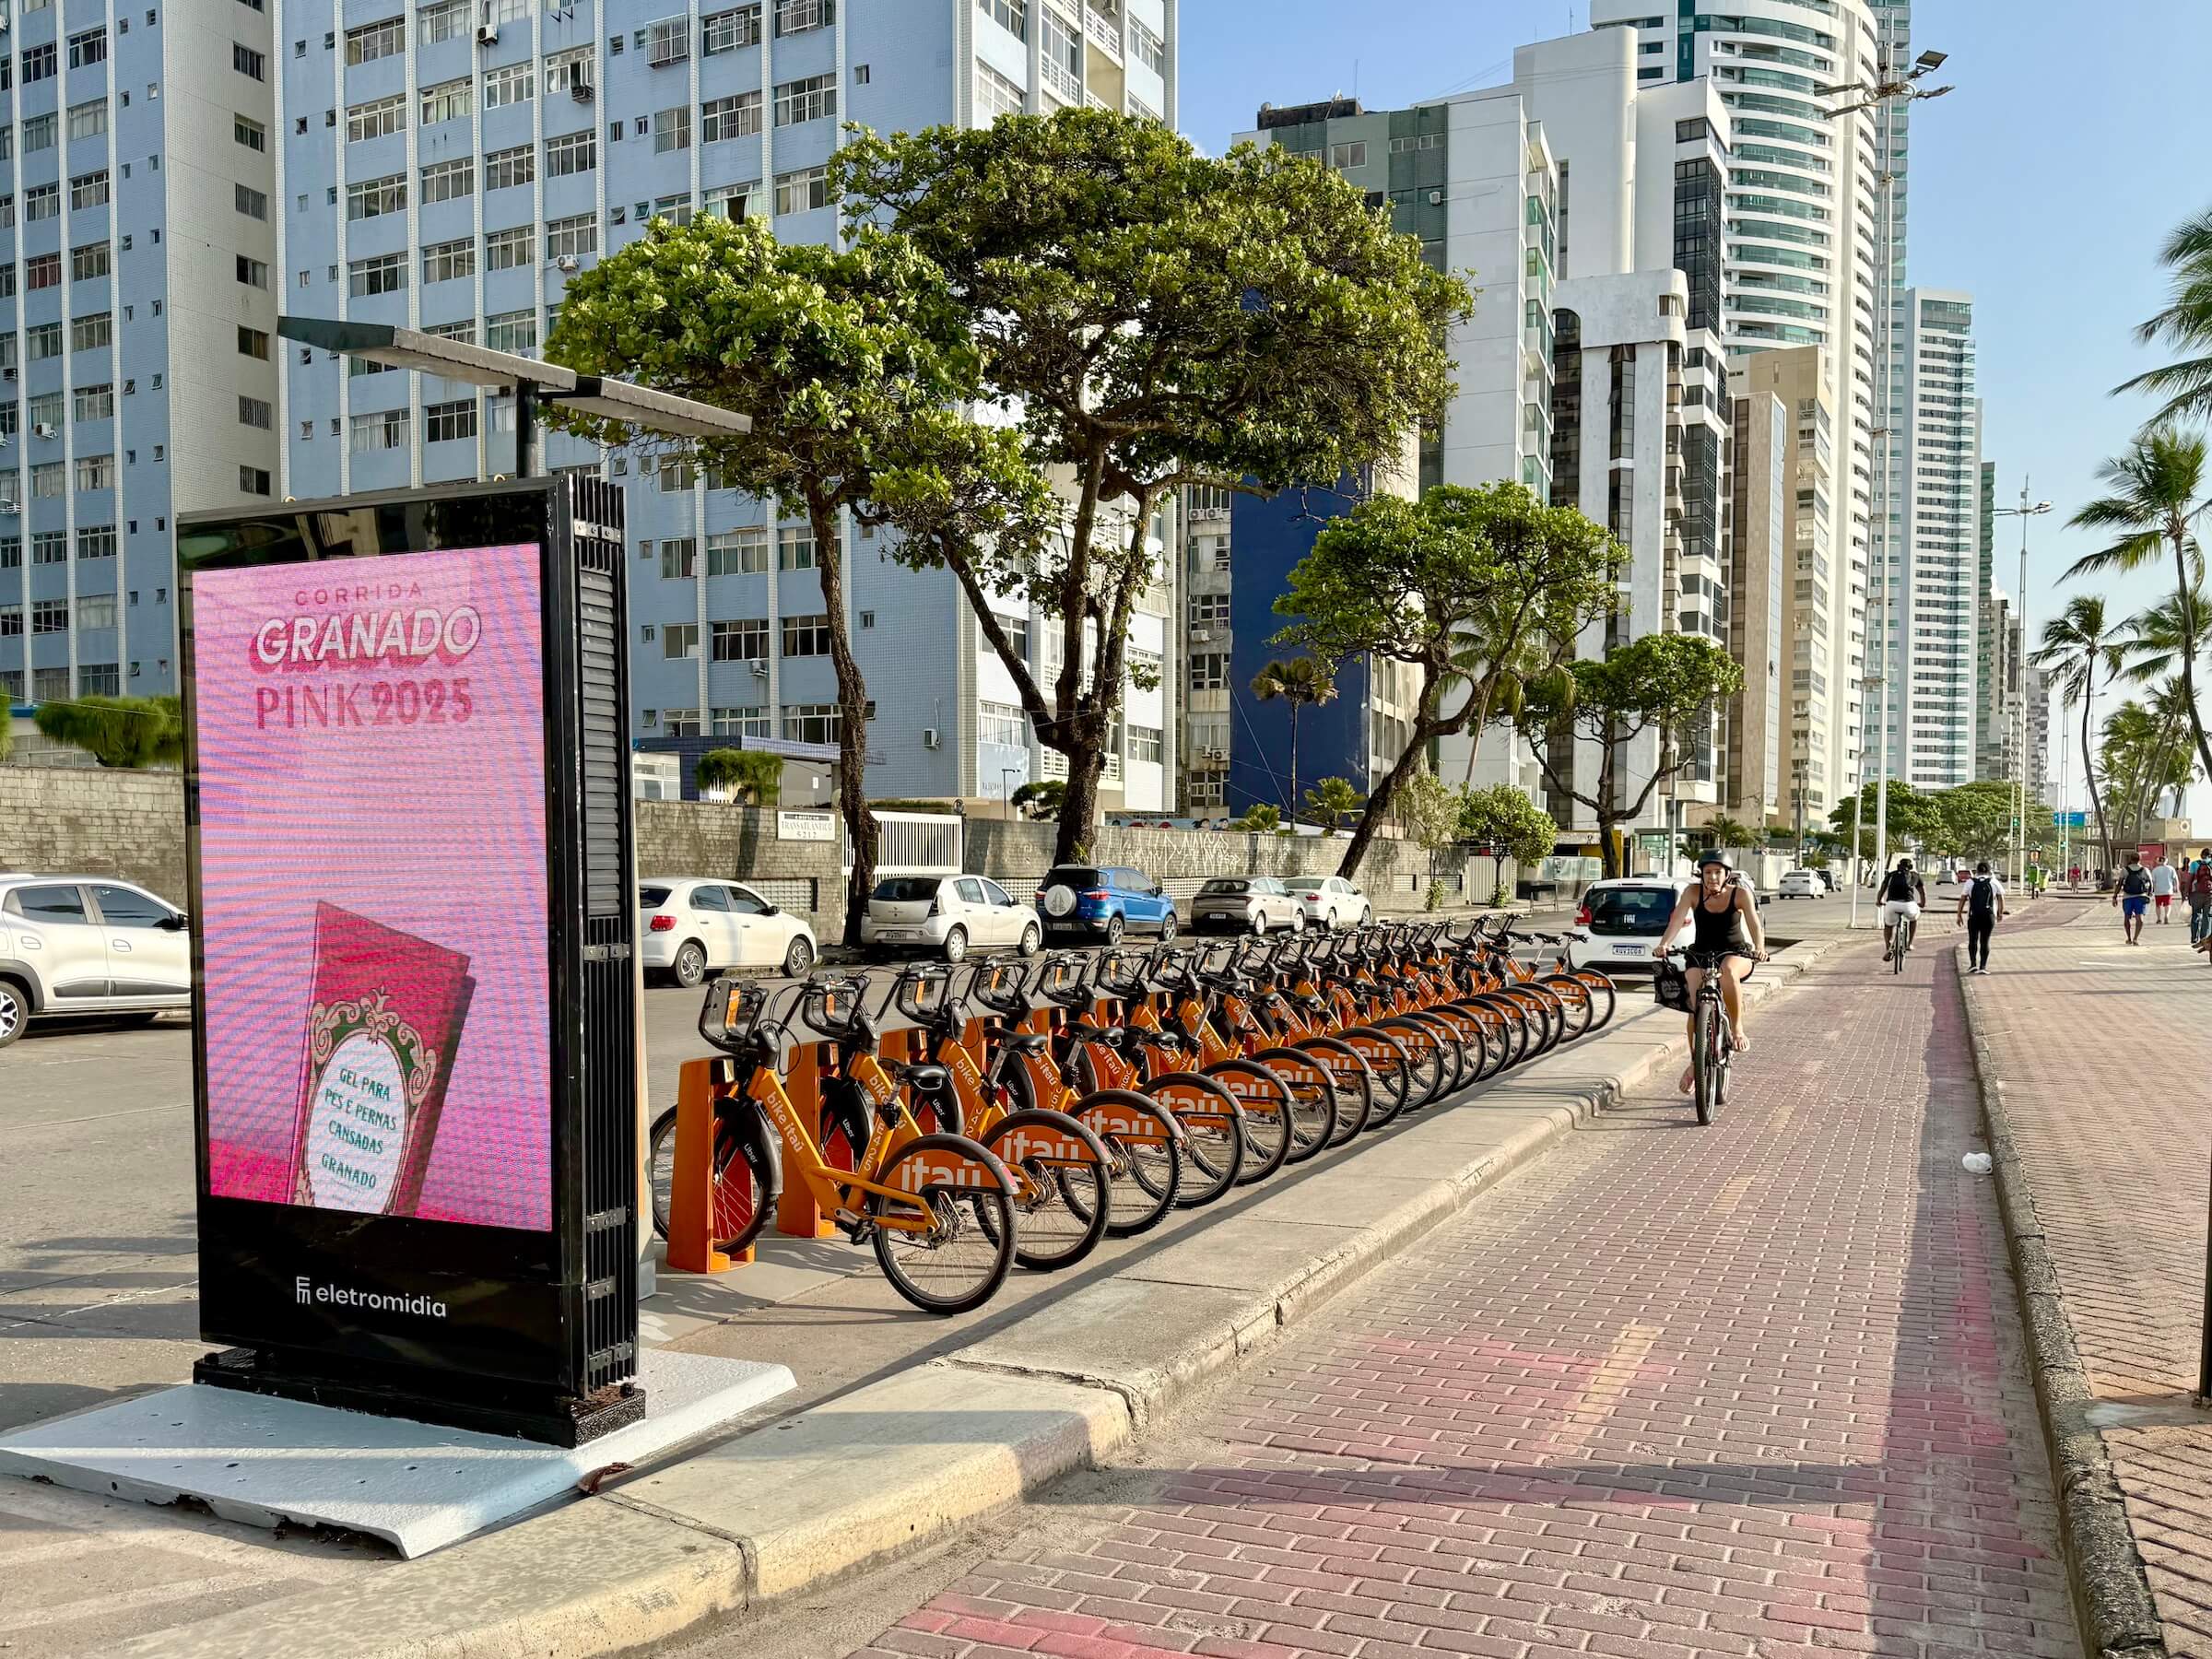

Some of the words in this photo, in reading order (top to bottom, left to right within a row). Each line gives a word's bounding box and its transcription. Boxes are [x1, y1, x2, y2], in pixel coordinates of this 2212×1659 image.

[295, 582, 422, 606] CORRIDA
[252, 605, 482, 672] GRANADO
[257, 681, 363, 729] PINK
[370, 677, 473, 725] 2025
[339, 1068, 359, 1089] GEL
[361, 1077, 391, 1102] PARA
[955, 1058, 975, 1087] bike
[1039, 1063, 1058, 1088] itaú
[346, 1099, 354, 1114] E
[355, 1104, 397, 1131] PERNAS
[766, 1090, 787, 1126] bike
[783, 1122, 806, 1153] itaú
[842, 1118, 855, 1139] Uber
[328, 1120, 384, 1155] CANSADAS
[744, 1143, 759, 1164] Uber
[1003, 1131, 1079, 1164] itaú
[322, 1152, 377, 1189] GRANADO
[901, 1156, 982, 1194] itaú
[315, 1283, 447, 1318] eletromidia
